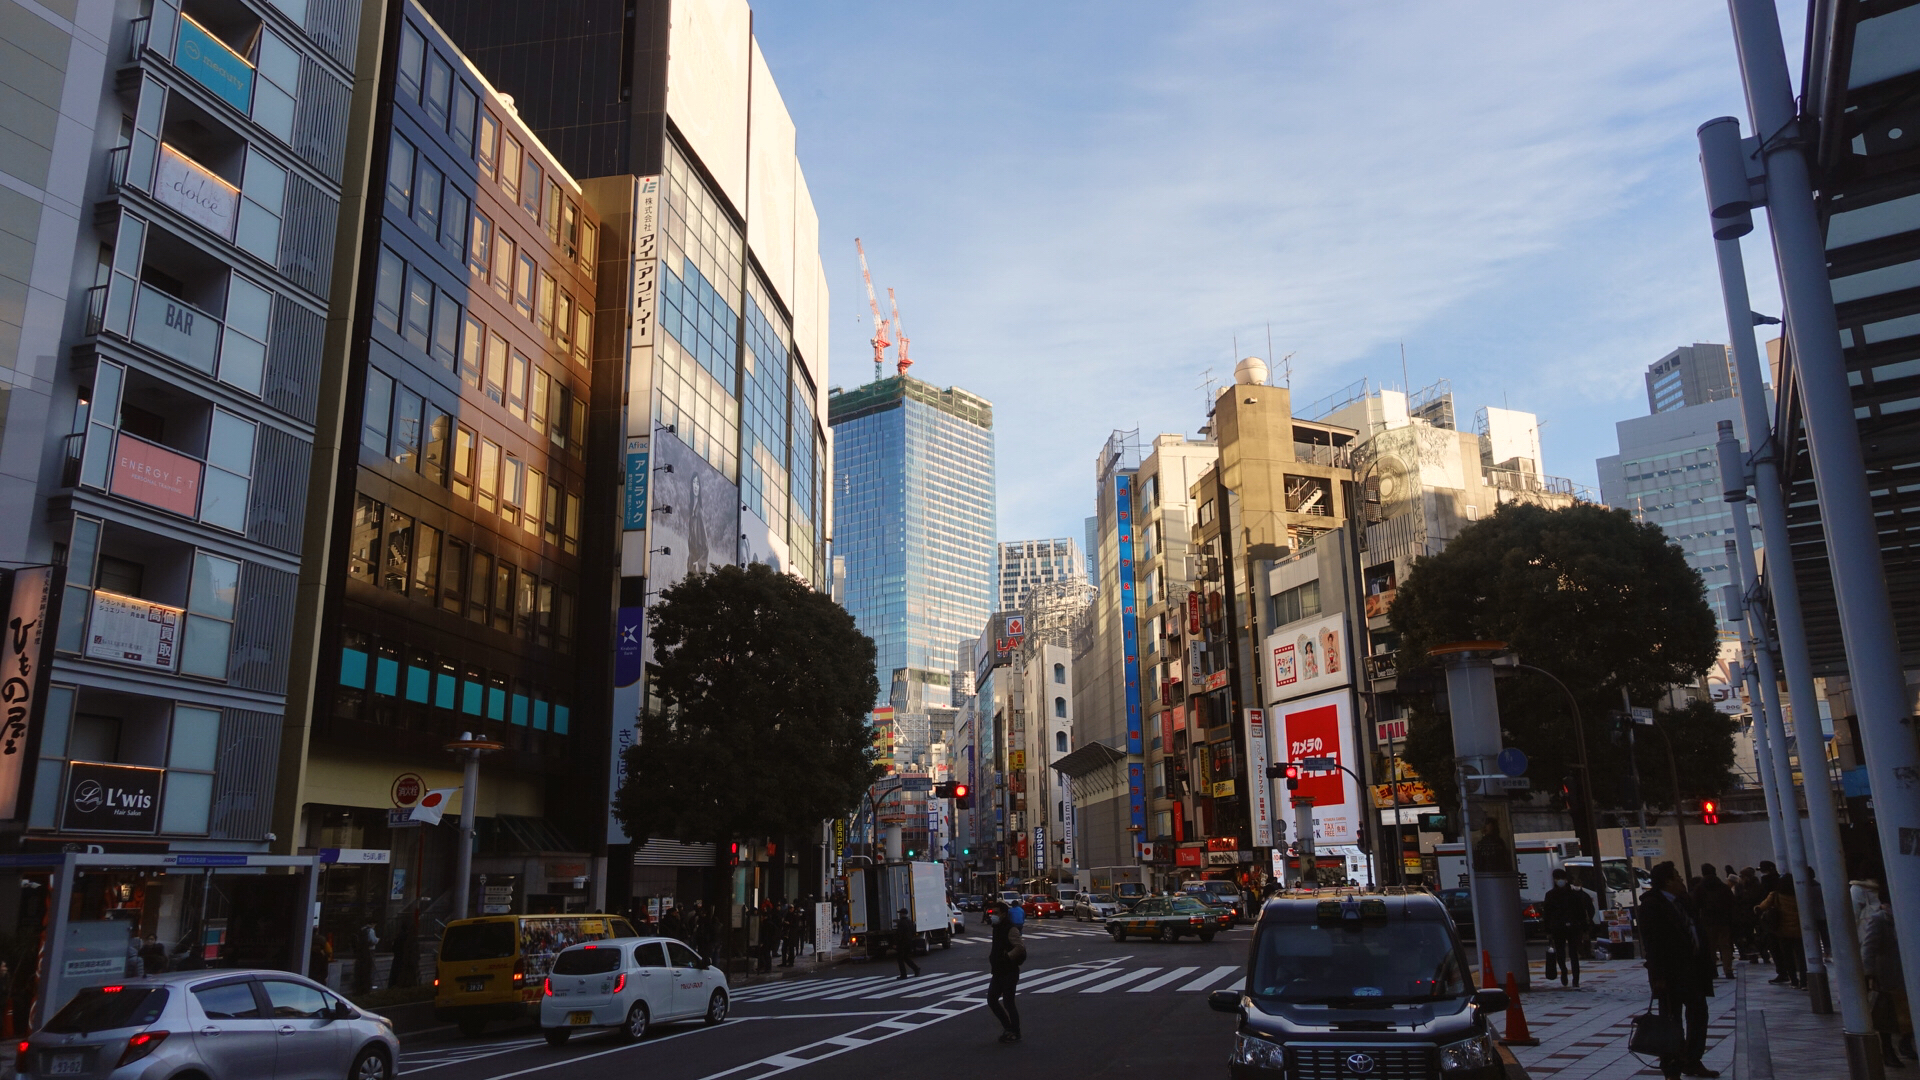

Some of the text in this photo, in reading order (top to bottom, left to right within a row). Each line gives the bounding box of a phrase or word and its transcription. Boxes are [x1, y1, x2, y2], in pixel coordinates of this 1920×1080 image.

[203, 56, 244, 90] meauty
[166, 171, 227, 217] dolce
[644, 197, 653, 232] 株式会社
[637, 233, 655, 336] アイ・アンド・イー
[165, 303, 194, 337] BAR
[628, 441, 648, 449] Aflac
[121, 457, 194, 489] ENERGY FT
[131, 473, 157, 487] PERSONAL
[633, 459, 646, 523] アフラック
[1277, 656, 1293, 666] スタジオ
[1378, 721, 1407, 740] NAIL
[1291, 737, 1322, 755] カメラの
[106, 788, 151, 808] L'wis
[399, 786, 418, 796] 消火栓
[363, 852, 386, 861] きらぼし銀行
